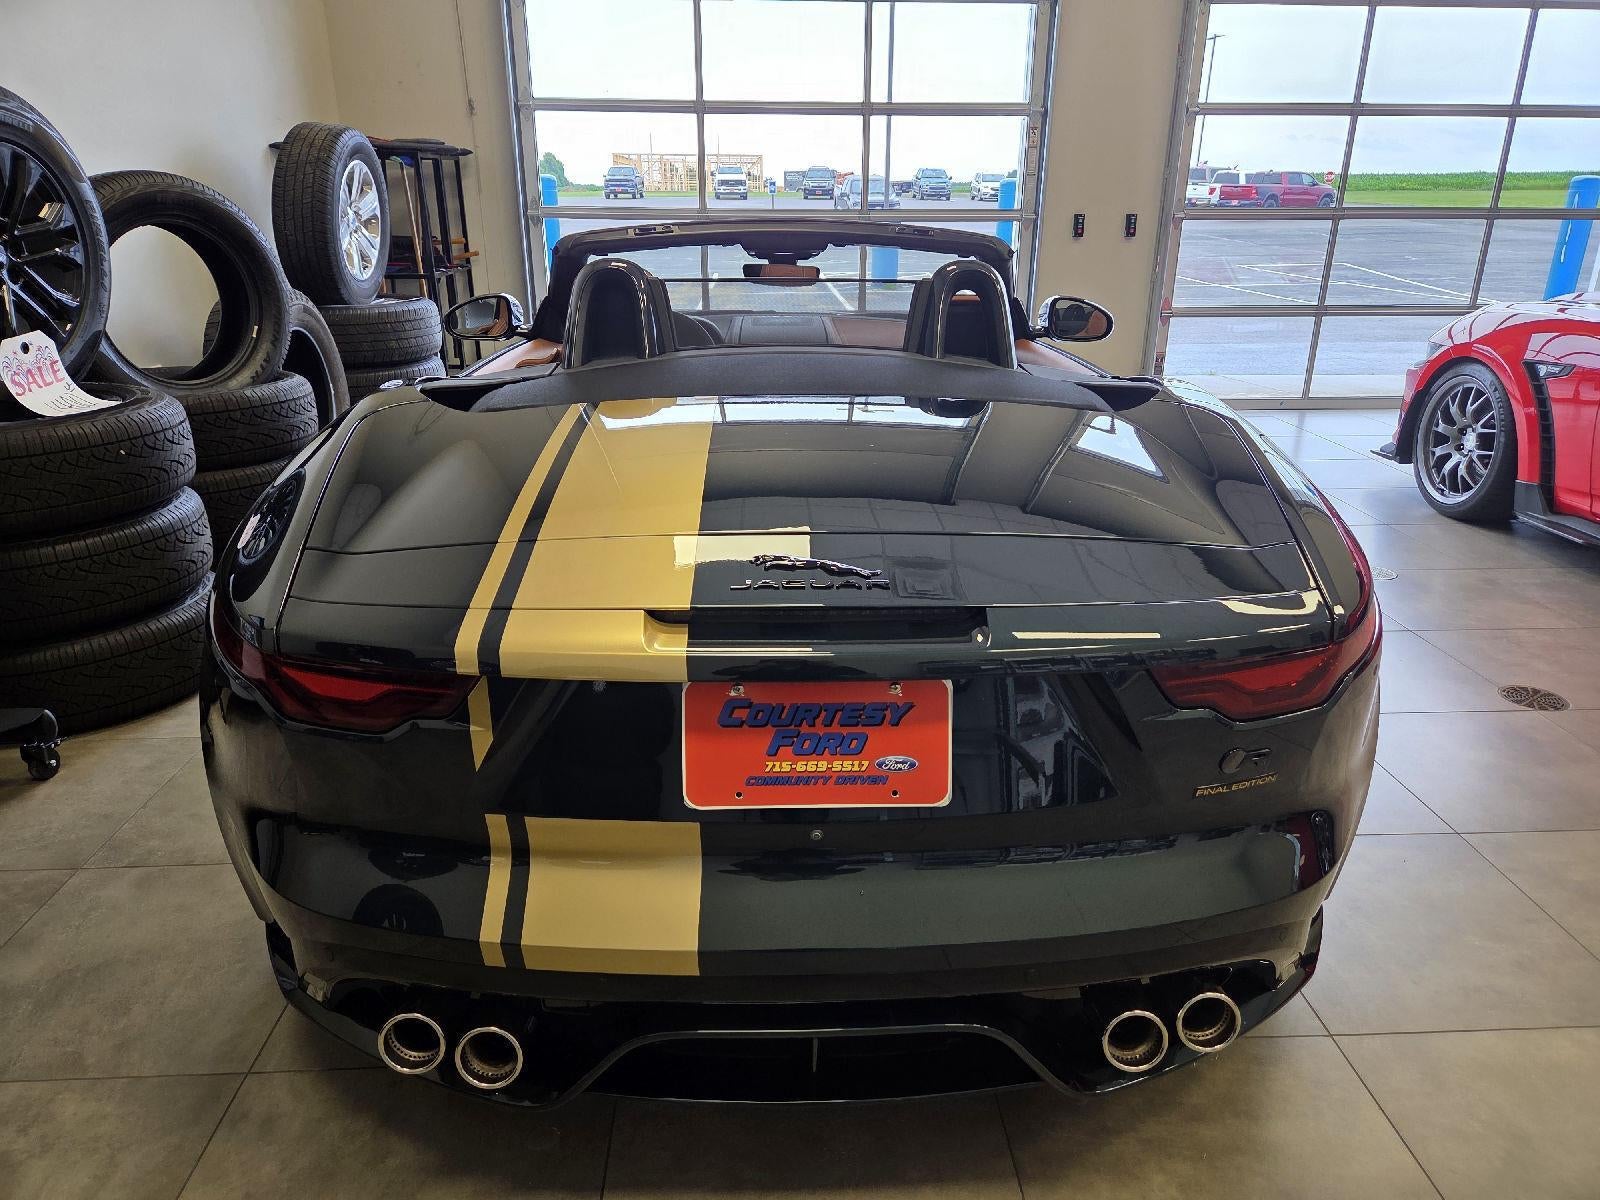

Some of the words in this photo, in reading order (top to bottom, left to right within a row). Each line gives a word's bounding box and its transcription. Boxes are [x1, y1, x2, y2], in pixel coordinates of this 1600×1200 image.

[10, 360, 65, 397] SALE
[730, 579, 891, 590] JAGUAR
[764, 760, 870, 772] 715-669-5517
[881, 758, 911, 770] Ford
[745, 775, 832, 787] COMMUNITY
[833, 775, 889, 786] DRIVEN
[1195, 785, 1230, 797] FINAL
[1231, 774, 1279, 791] EDITION
